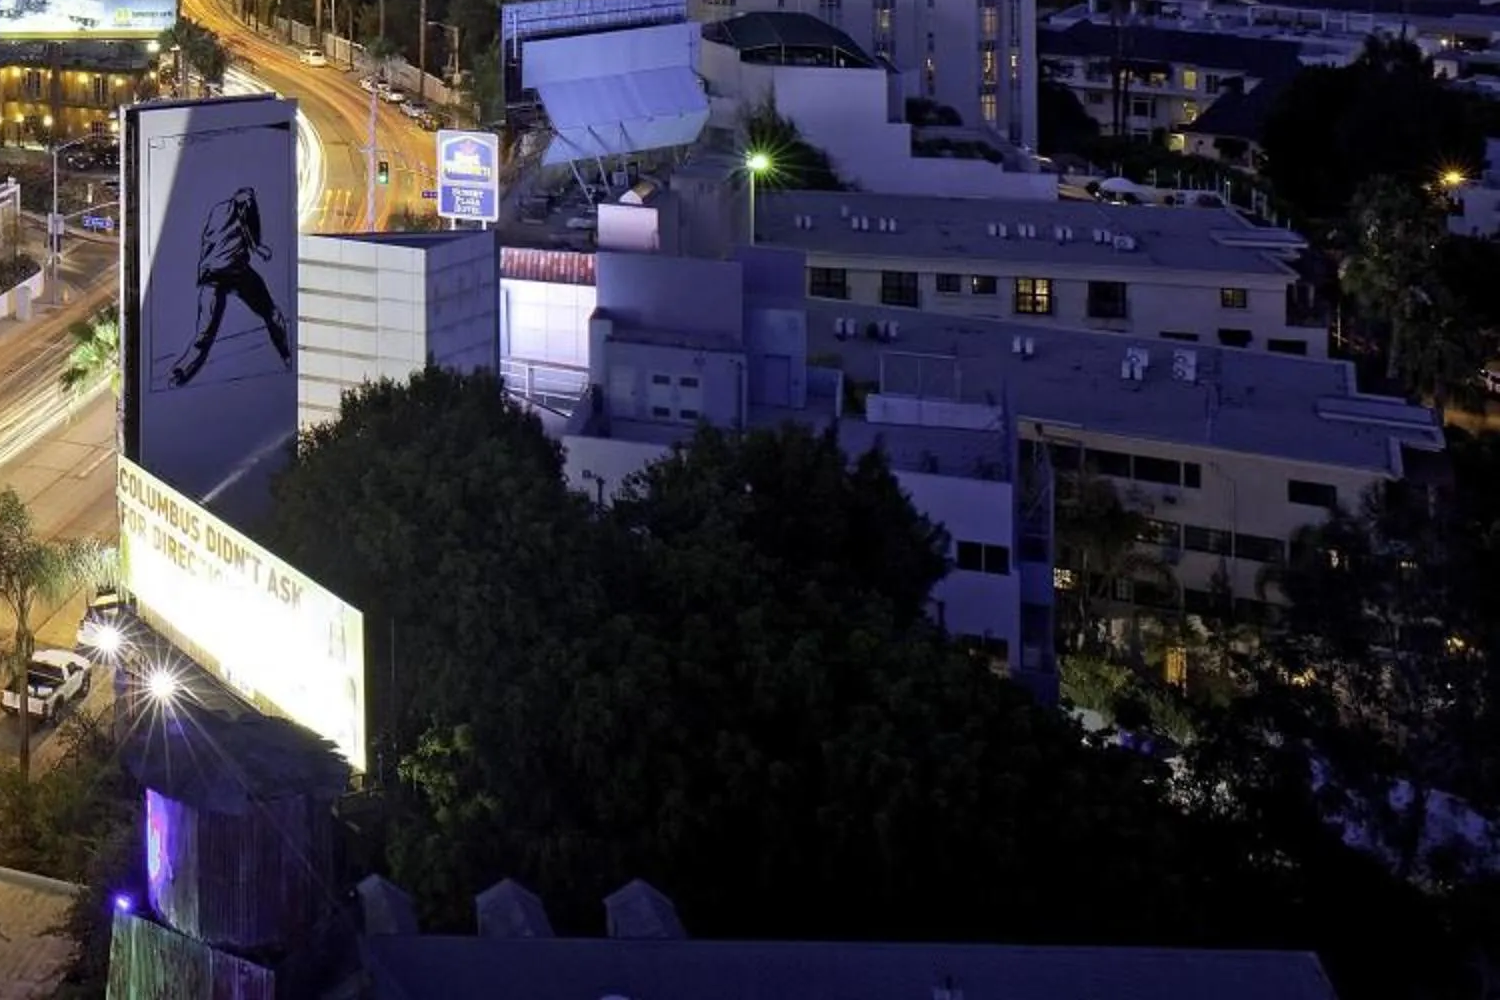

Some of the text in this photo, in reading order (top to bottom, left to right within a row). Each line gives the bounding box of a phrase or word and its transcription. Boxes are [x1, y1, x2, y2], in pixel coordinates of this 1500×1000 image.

[120, 502, 147, 538] FOR
[120, 467, 303, 611] COLUMBUS DIDN'T ASK
